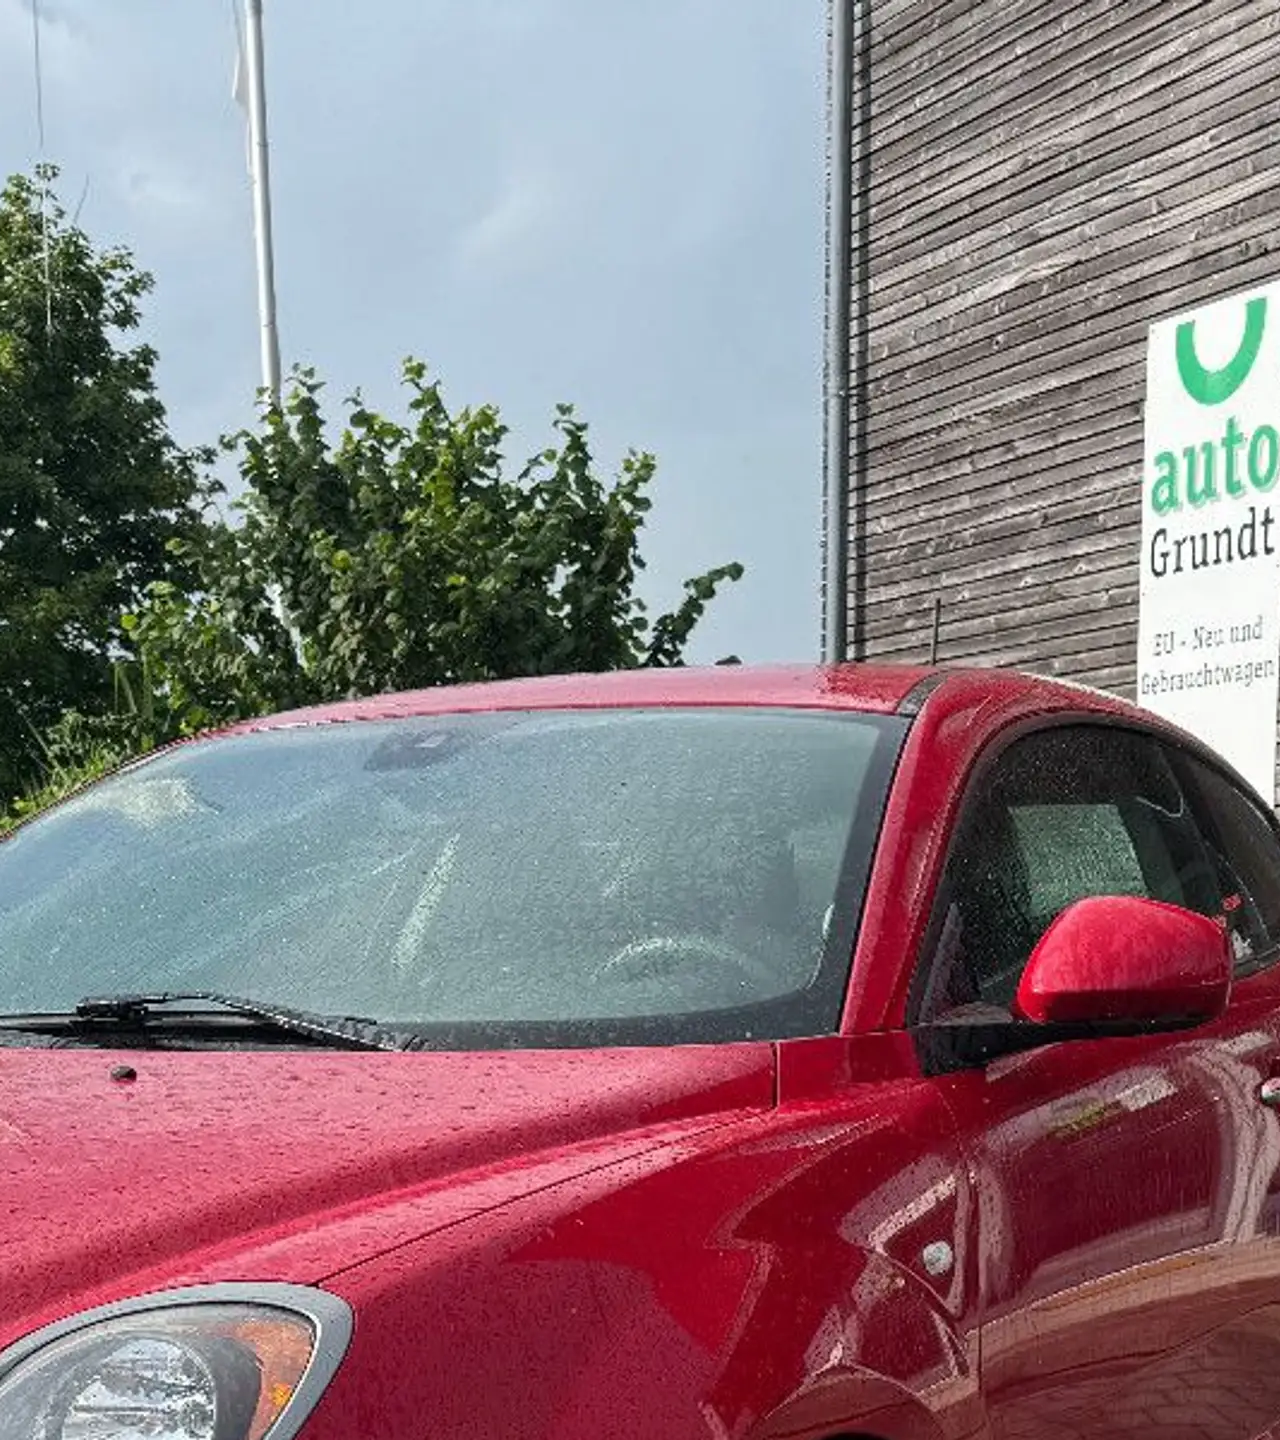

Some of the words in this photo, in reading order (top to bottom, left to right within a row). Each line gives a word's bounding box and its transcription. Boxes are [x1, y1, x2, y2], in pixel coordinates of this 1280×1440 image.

[1151, 415, 1280, 514] auto
[1150, 506, 1275, 578] Grundt
[1153, 630, 1175, 656] EU
[1192, 626, 1224, 651] Neu
[1230, 614, 1263, 643] und
[1141, 659, 1275, 695] Gebrauchtwagen
